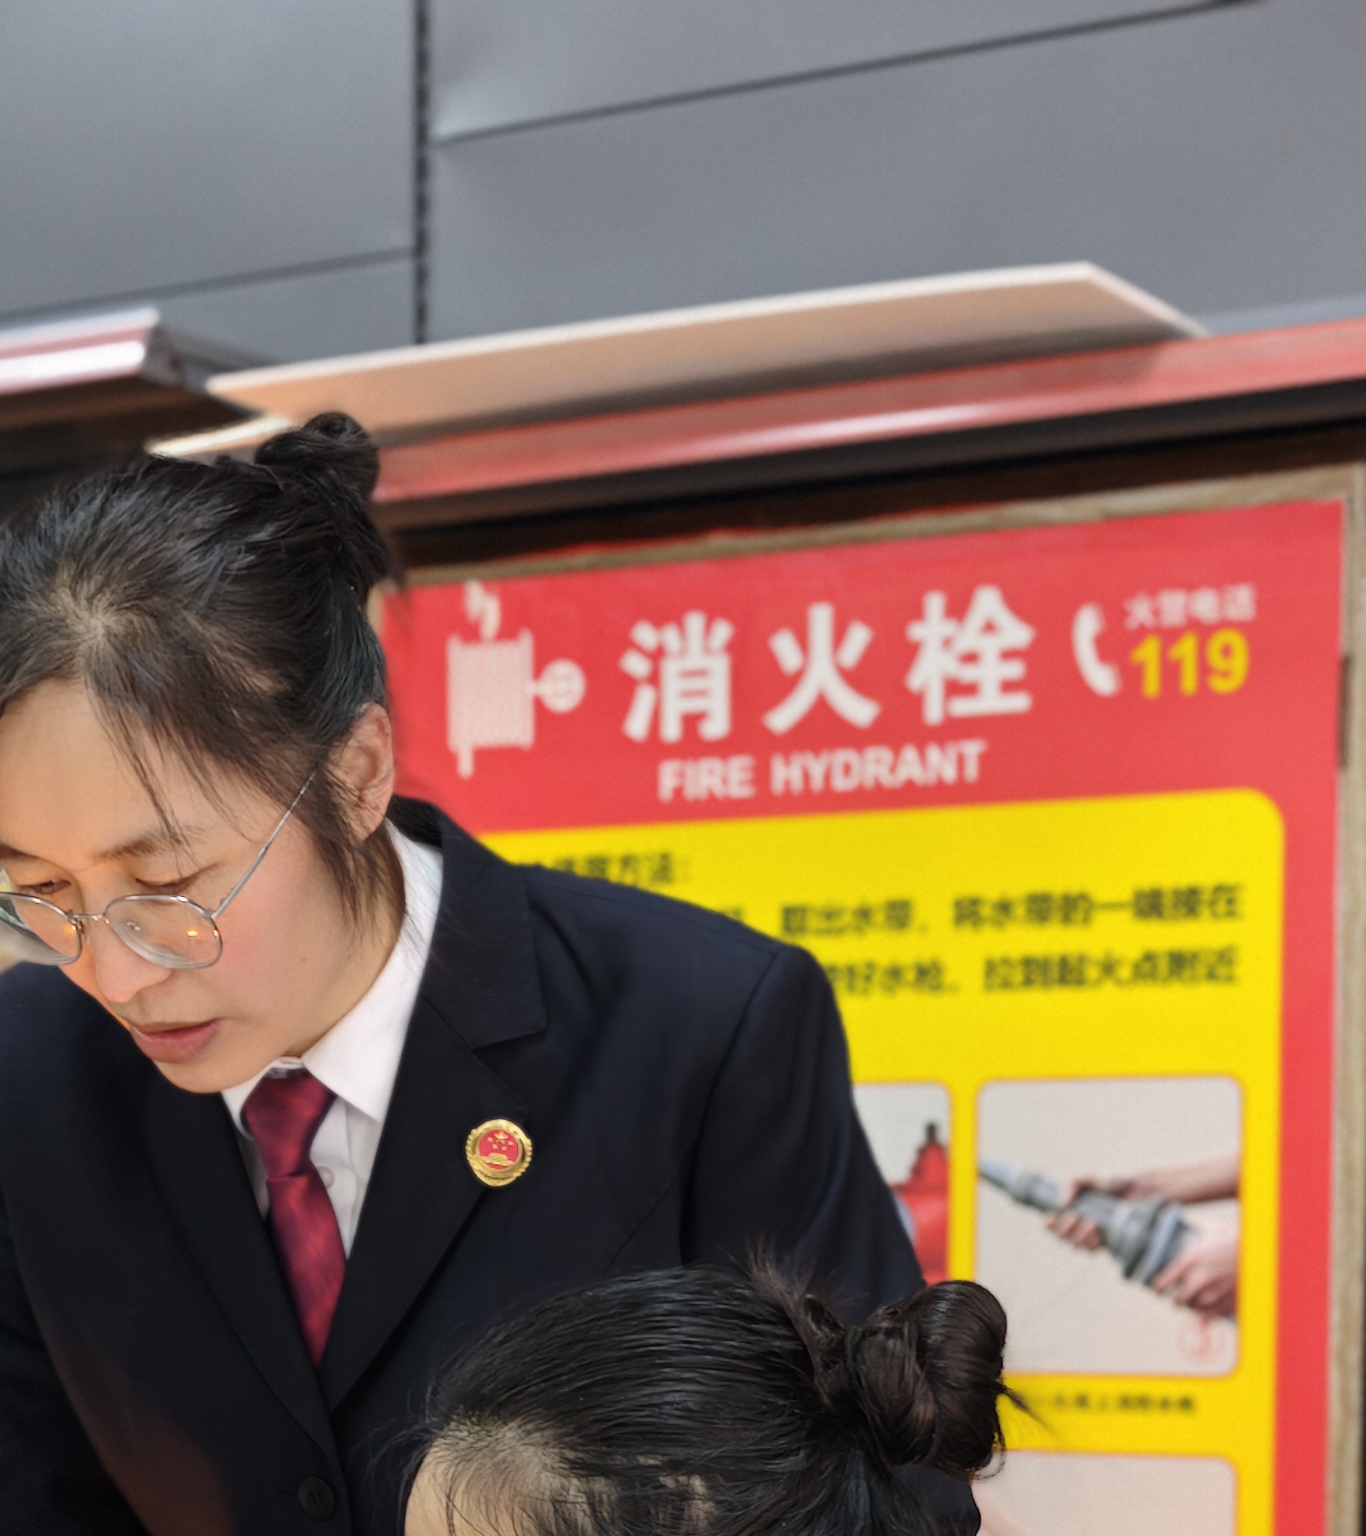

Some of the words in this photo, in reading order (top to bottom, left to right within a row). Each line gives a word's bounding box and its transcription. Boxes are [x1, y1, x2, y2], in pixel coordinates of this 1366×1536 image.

[620, 586, 1035, 743] 消火栓
[1129, 628, 1250, 699] 119
[657, 756, 756, 803] FIRE
[771, 739, 987, 796] HYDRANT
